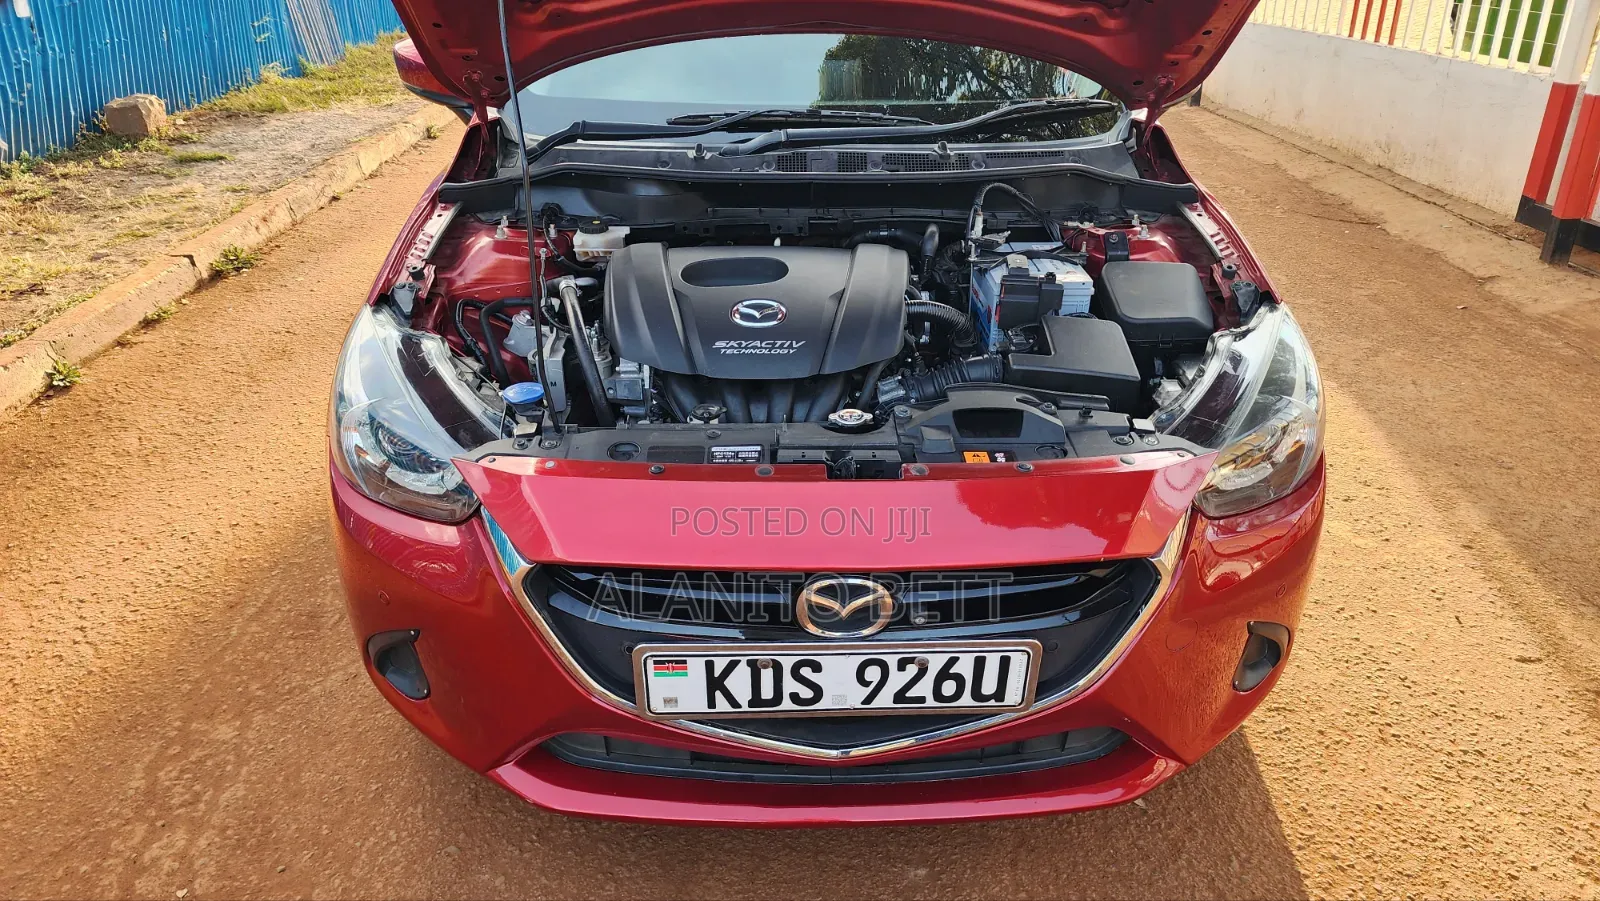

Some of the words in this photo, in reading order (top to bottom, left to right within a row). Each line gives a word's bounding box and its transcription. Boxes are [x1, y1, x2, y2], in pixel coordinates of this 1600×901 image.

[712, 340, 806, 348] SKYACTIV
[704, 657, 824, 710] KDS
[855, 654, 1012, 706] 926U
